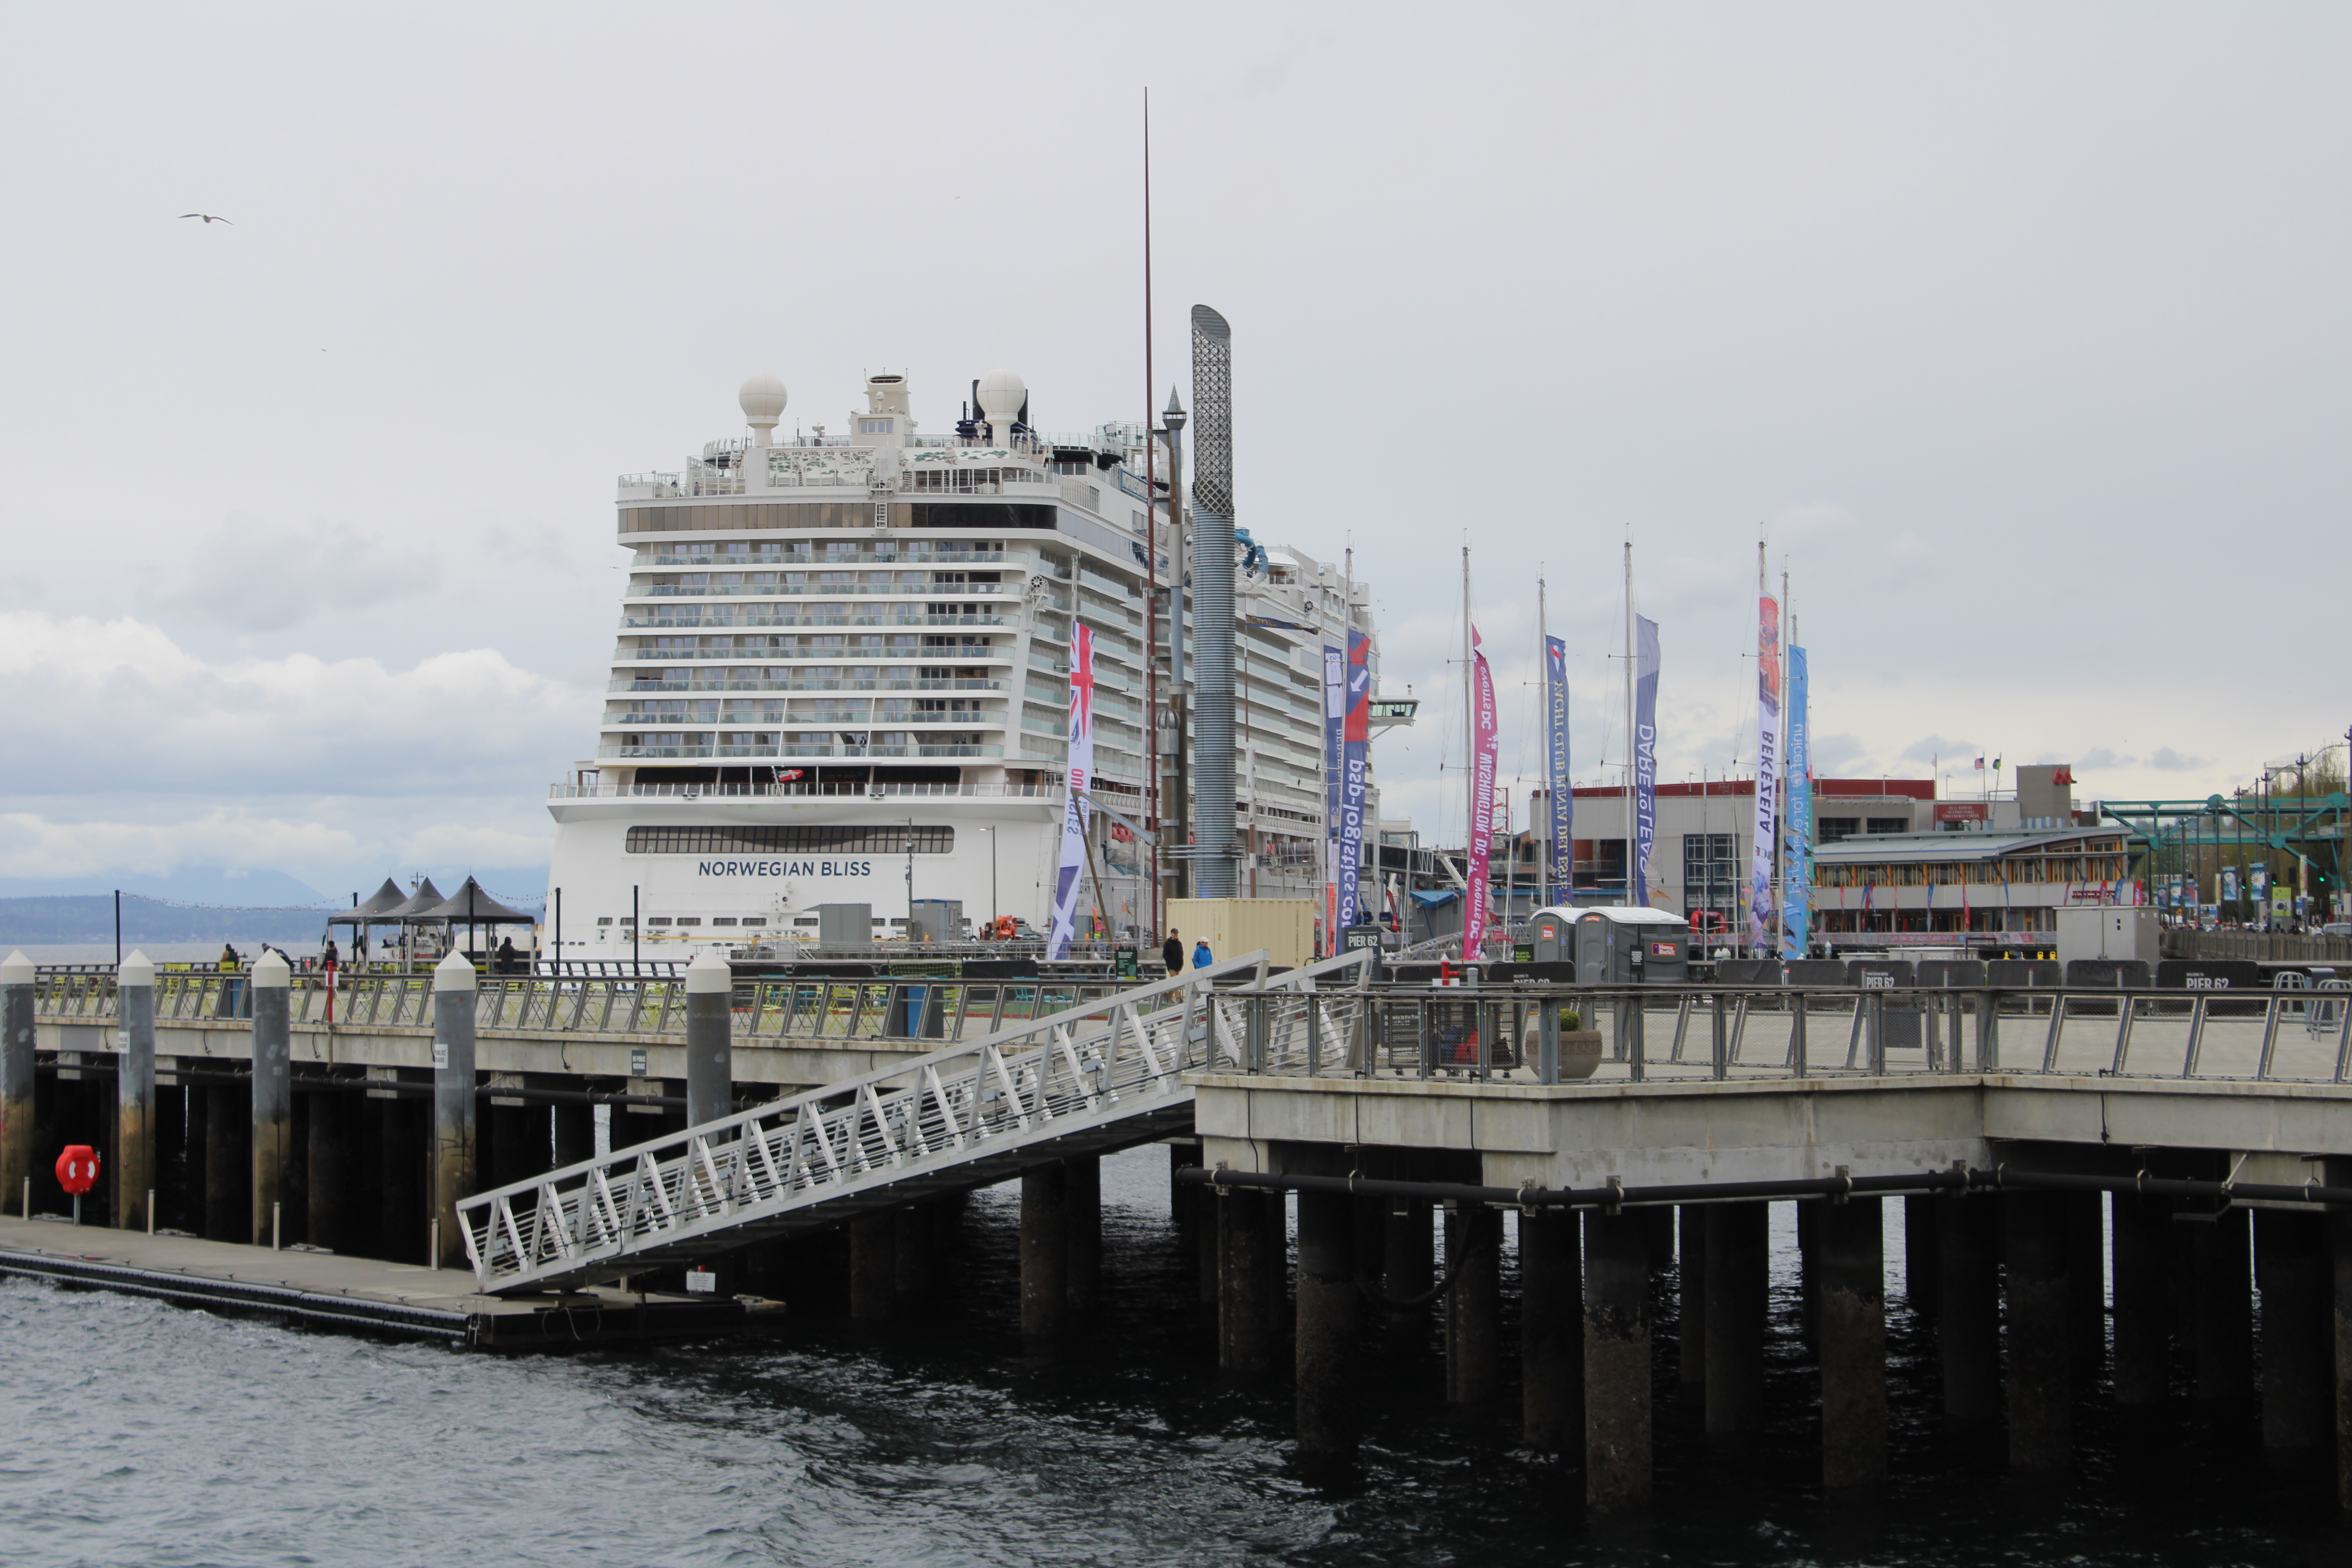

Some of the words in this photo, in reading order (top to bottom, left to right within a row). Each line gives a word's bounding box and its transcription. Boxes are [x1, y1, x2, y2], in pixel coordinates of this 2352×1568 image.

[2053, 768, 2072, 785] 66
[699, 862, 815, 877] NORWEGIAN
[821, 862, 871, 877] BLISS
[1348, 936, 1367, 947] PIER
[1367, 935, 1378, 947] 62
[1867, 977, 1883, 988] PIER
[1884, 977, 1895, 987] 62
[2187, 978, 2212, 988] PIER
[2214, 978, 2229, 988] 62
